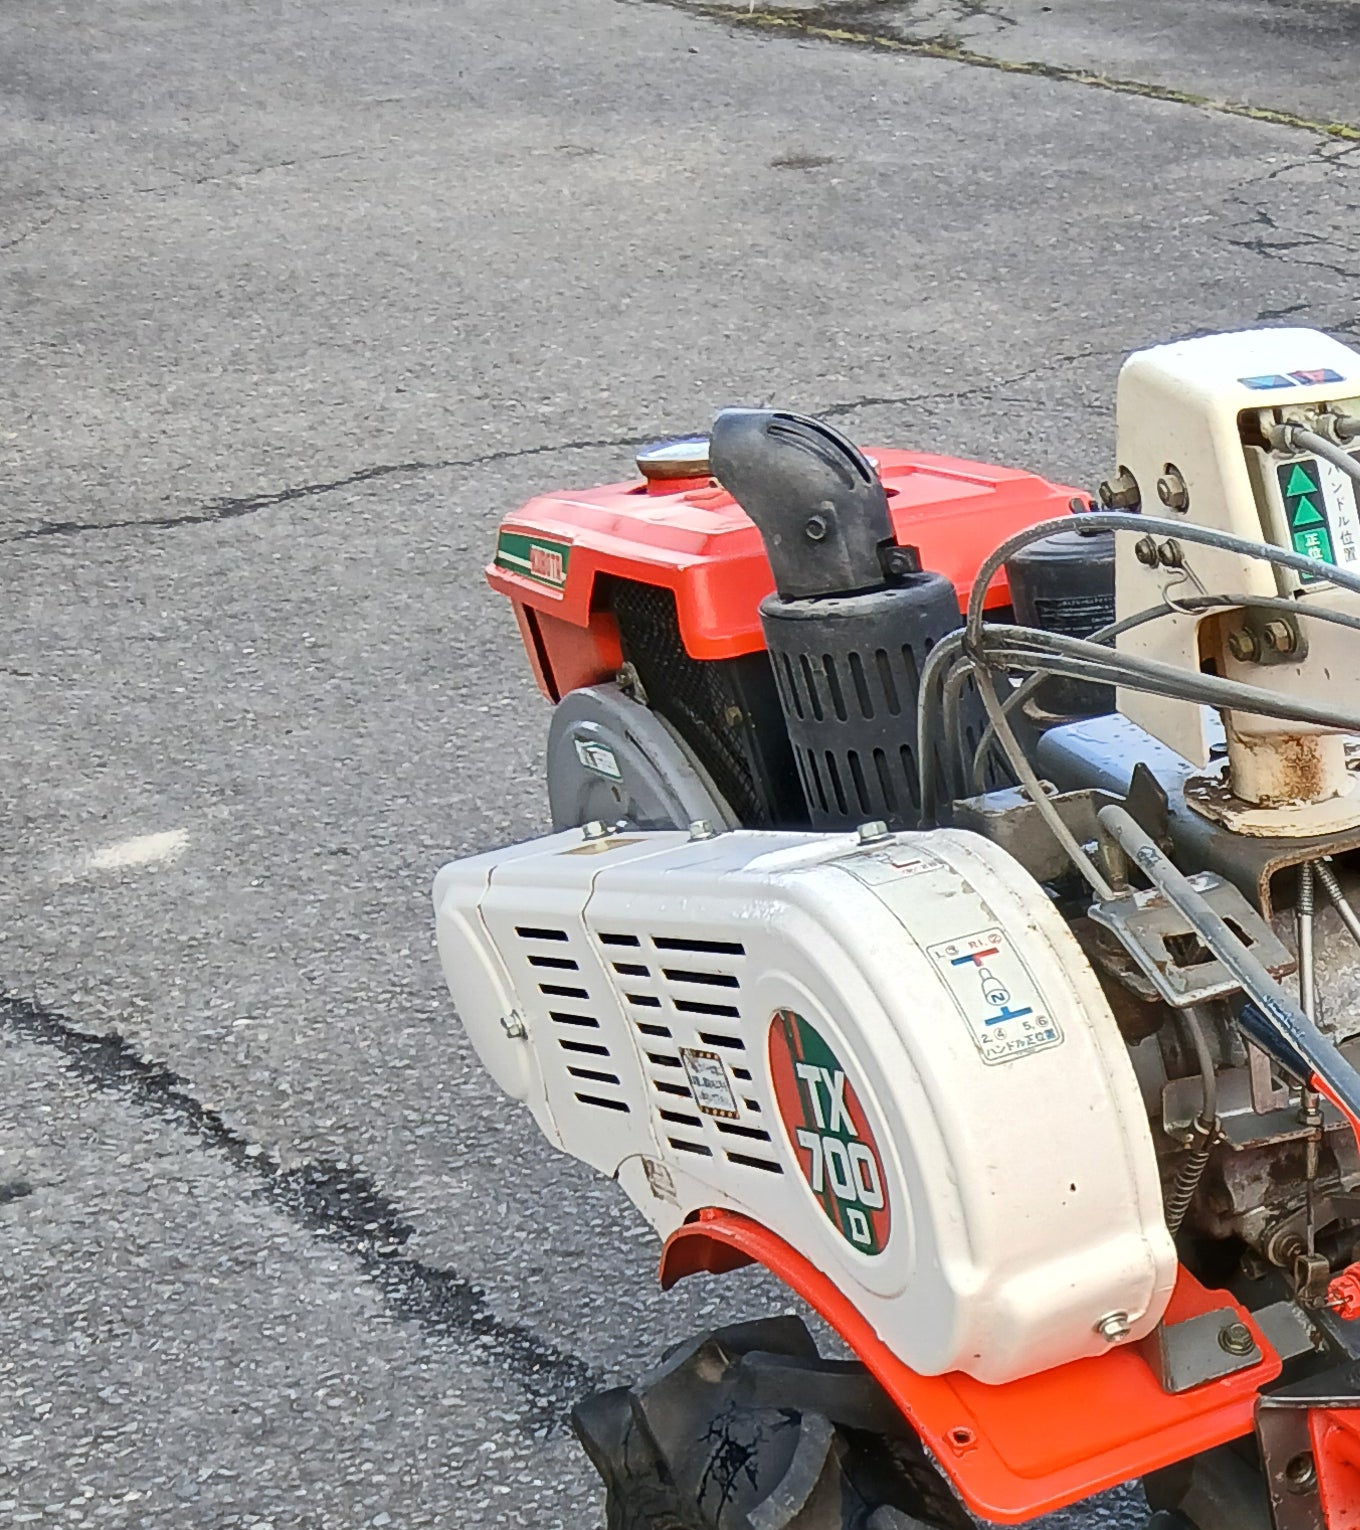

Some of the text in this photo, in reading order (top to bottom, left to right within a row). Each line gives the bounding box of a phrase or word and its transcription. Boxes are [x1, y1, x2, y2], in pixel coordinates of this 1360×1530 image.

[1304, 532, 1324, 562] 正位
[990, 992, 1006, 1003] N
[795, 1062, 859, 1137] TX
[796, 1128, 885, 1210] 700
[846, 1207, 872, 1246] D
